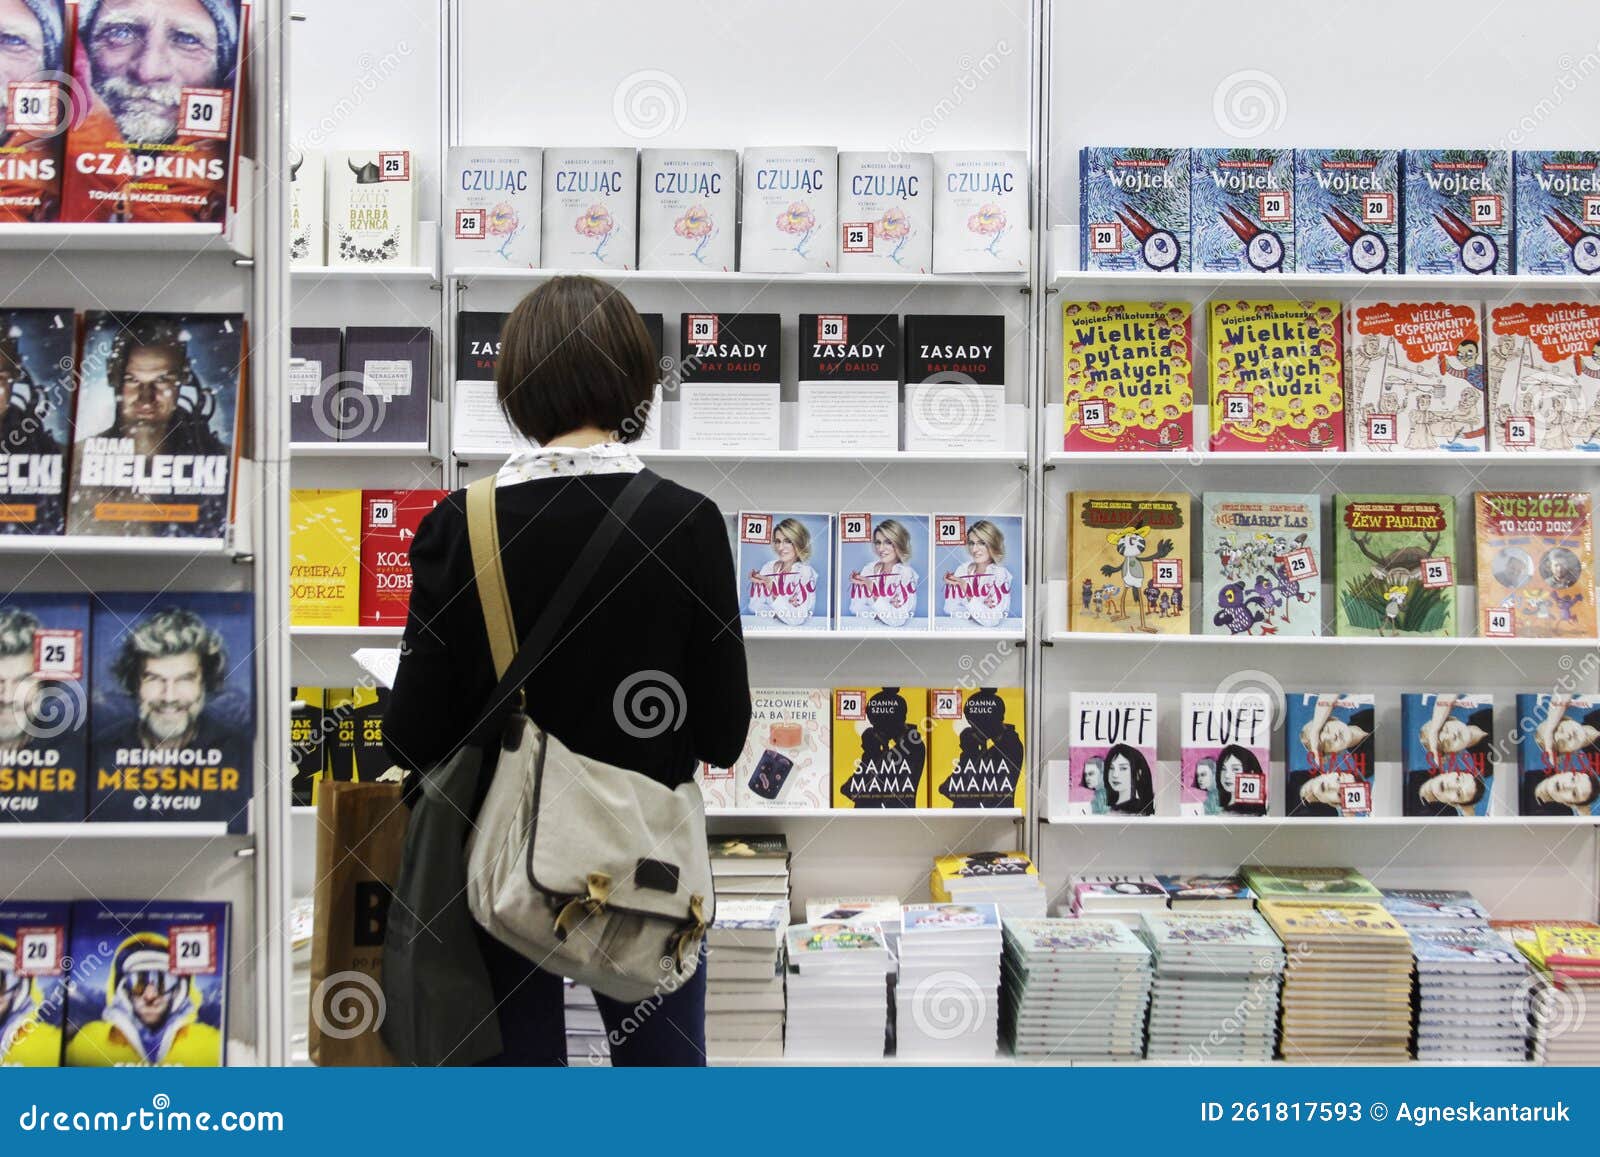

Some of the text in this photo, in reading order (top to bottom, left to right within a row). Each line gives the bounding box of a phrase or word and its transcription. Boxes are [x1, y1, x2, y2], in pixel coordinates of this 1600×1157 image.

[20, 97, 40, 114] 30
[191, 104, 213, 121] 30
[76, 153, 224, 180] CZAPKINS
[386, 160, 399, 171] 25
[462, 170, 528, 195] CZUJĄC
[556, 171, 622, 196] CZUJĄC
[655, 173, 721, 198] CZUJĄC
[757, 169, 823, 194] CZUJĄC
[852, 175, 919, 200] CZUJĄC
[947, 173, 1013, 196] CZUJĄC
[1106, 169, 1175, 192] Wojtek
[1210, 170, 1279, 193] Wojtek
[1314, 171, 1383, 194] Wojtek
[1424, 172, 1493, 194] Wojtek
[1267, 201, 1280, 211] 20
[1370, 203, 1382, 213] 20
[1477, 205, 1491, 216] 20
[350, 209, 389, 219] BARBA
[463, 218, 475, 229] 25
[850, 231, 863, 242] 25
[1098, 233, 1111, 243] 20
[1072, 314, 1113, 326] Wojciech
[1221, 314, 1263, 326] Wojciech
[1394, 317, 1472, 336] EKSPERYMENTY
[695, 323, 709, 335] 30
[824, 323, 838, 335] 30
[1076, 323, 1172, 346] Wielkie
[1225, 323, 1321, 346] Wielkie
[1424, 329, 1464, 342] MAŁYCH
[695, 344, 768, 358] ZASADY
[813, 344, 885, 358] ZASADY
[920, 345, 993, 359] ZASADY
[1085, 342, 1173, 369] pytania
[1234, 342, 1322, 369] pytania
[701, 363, 761, 372] RAY DALIO
[819, 363, 879, 372] RAY DALIO
[927, 363, 987, 372] RAY DALIO
[1090, 360, 1171, 384] małych
[1239, 360, 1321, 384] małych
[1119, 379, 1172, 398] ludzi
[1268, 379, 1321, 398] ludzi
[1086, 409, 1099, 420] 25
[1230, 402, 1243, 413] 25
[1374, 424, 1387, 435] 25
[1512, 426, 1525, 437] 25
[83, 438, 135, 455] ADAM
[80, 454, 228, 487] BIELECKI
[376, 508, 388, 519] 20
[1490, 498, 1579, 518] PUSZCZA
[847, 522, 861, 533] 20
[1284, 514, 1308, 527] LAS
[1500, 518, 1572, 532] TO MÓJ DOM
[748, 523, 762, 534] 20
[942, 525, 956, 536] 20
[376, 552, 411, 567] KOC
[1292, 559, 1305, 570] 25
[1160, 568, 1173, 578] 25
[1429, 567, 1442, 578] 25
[1492, 616, 1505, 627] 40
[45, 646, 65, 662] 25
[755, 699, 808, 707] CZŁOWIEK
[843, 699, 857, 711] 20
[939, 698, 953, 710] 20
[1080, 707, 1153, 744] FLUFF
[1192, 708, 1265, 745] FLUFF
[115, 749, 222, 766] REINHOLD
[853, 758, 912, 774] SAMA
[952, 758, 1010, 774] SAMA
[97, 768, 239, 791] MESSNER
[850, 776, 915, 792] MAMA
[948, 776, 1014, 792] MAMA
[1241, 782, 1255, 793] 20
[133, 793, 202, 810] O ŻYCIU
[1347, 792, 1361, 803] 20
[27, 943, 47, 959] 20
[181, 941, 201, 958] 20
